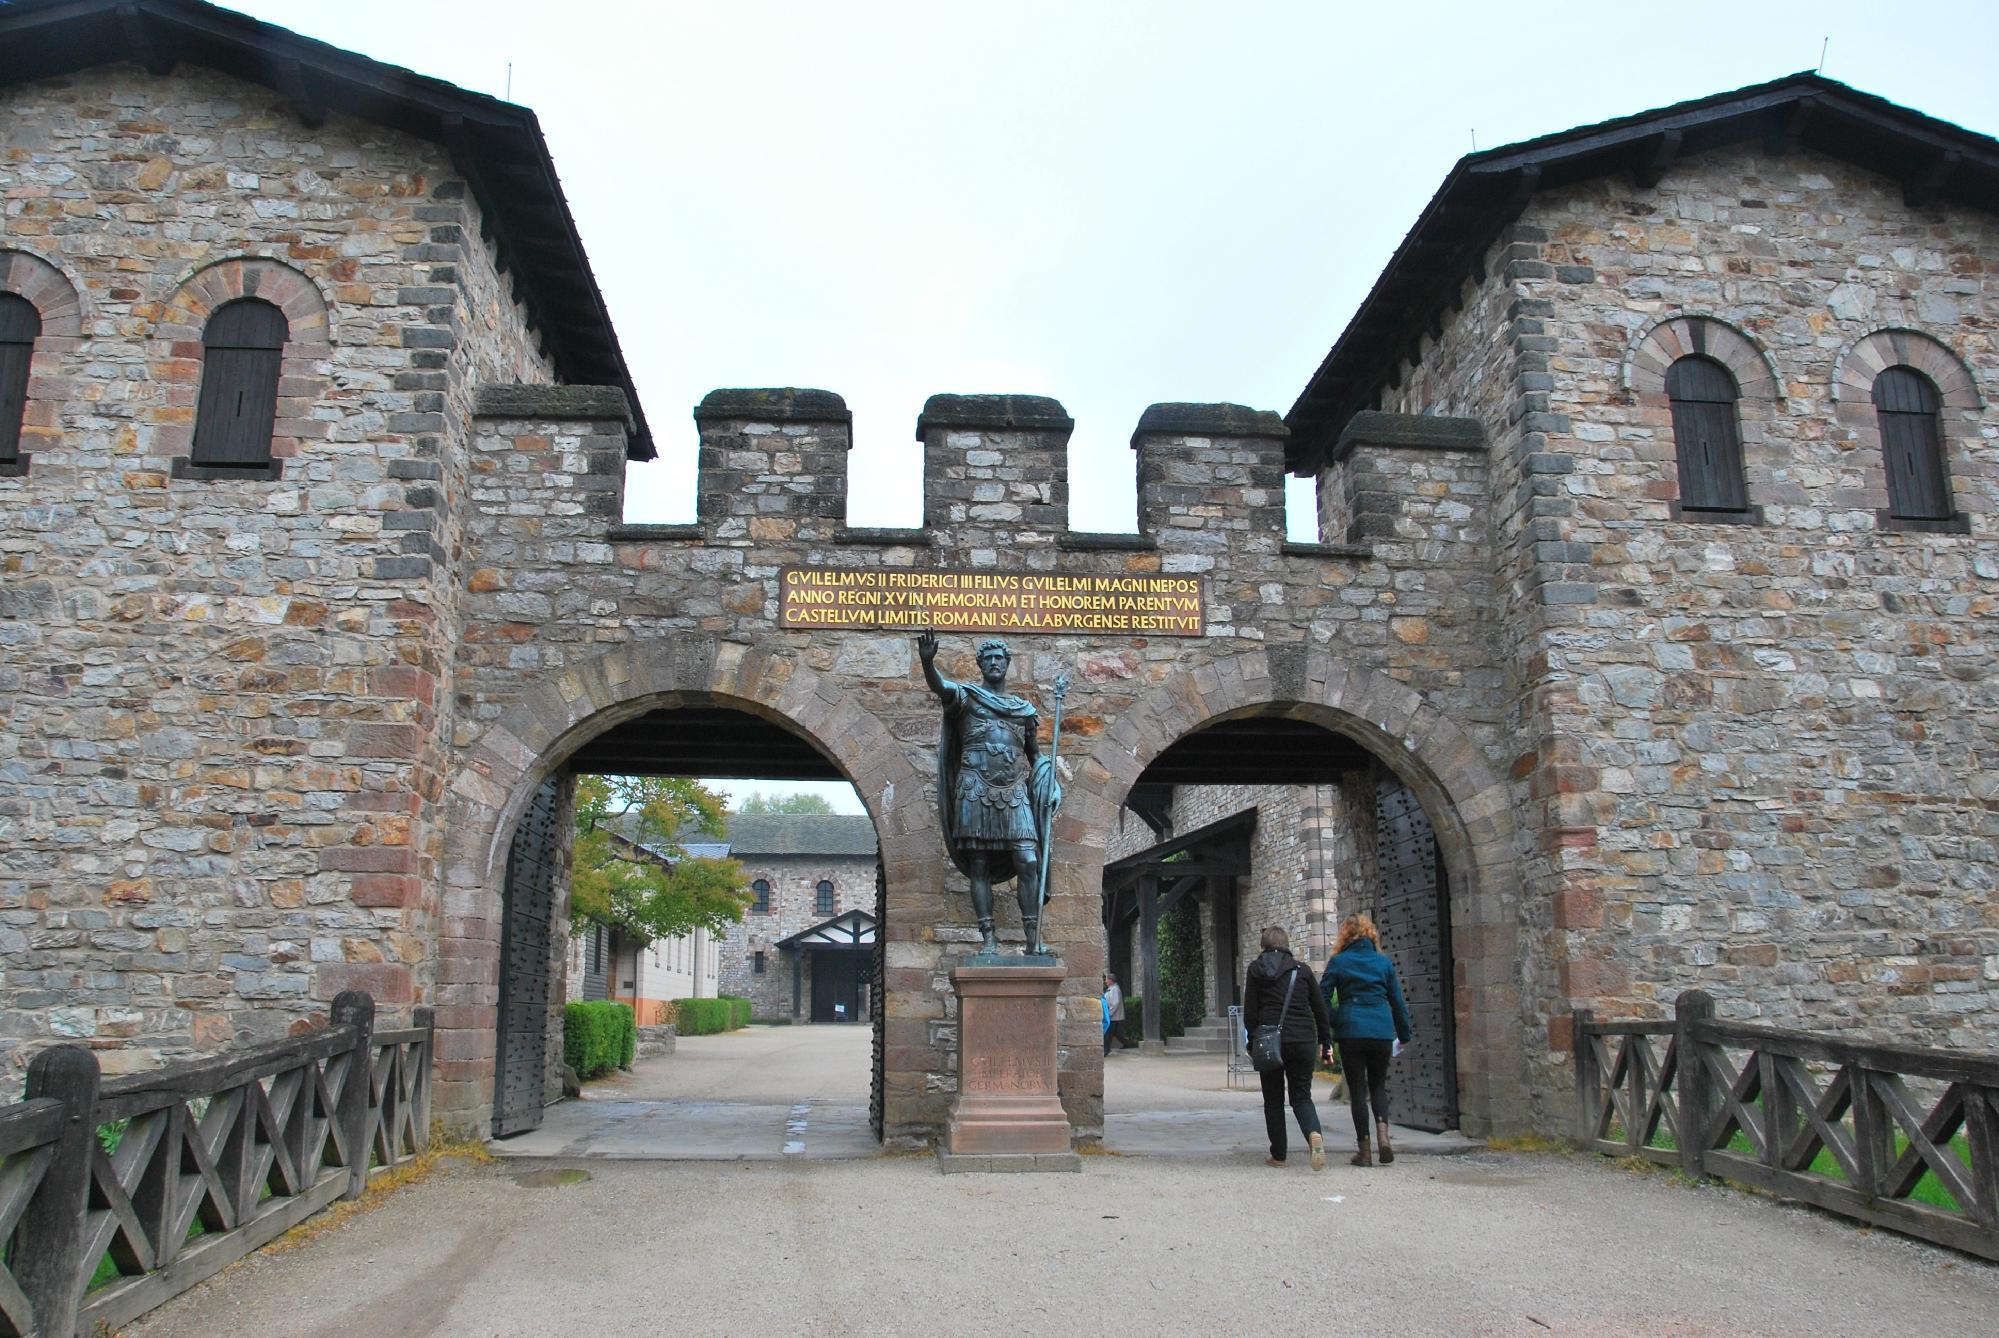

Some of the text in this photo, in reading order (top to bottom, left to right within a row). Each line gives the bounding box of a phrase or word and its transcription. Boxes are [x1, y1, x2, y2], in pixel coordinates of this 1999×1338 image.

[787, 571, 1198, 593] GVILELMVS II FRIDERICI III FILIVS GVILELMI MAGNI NEPOS
[787, 590, 1199, 611] ANNO REGNI XV IN MEMORIAM ET HONOREM PARENTVM
[786, 609, 1201, 629] CASTELLVM LIMITIS ROMANI SAALABVRGENSE RESTITVIT
